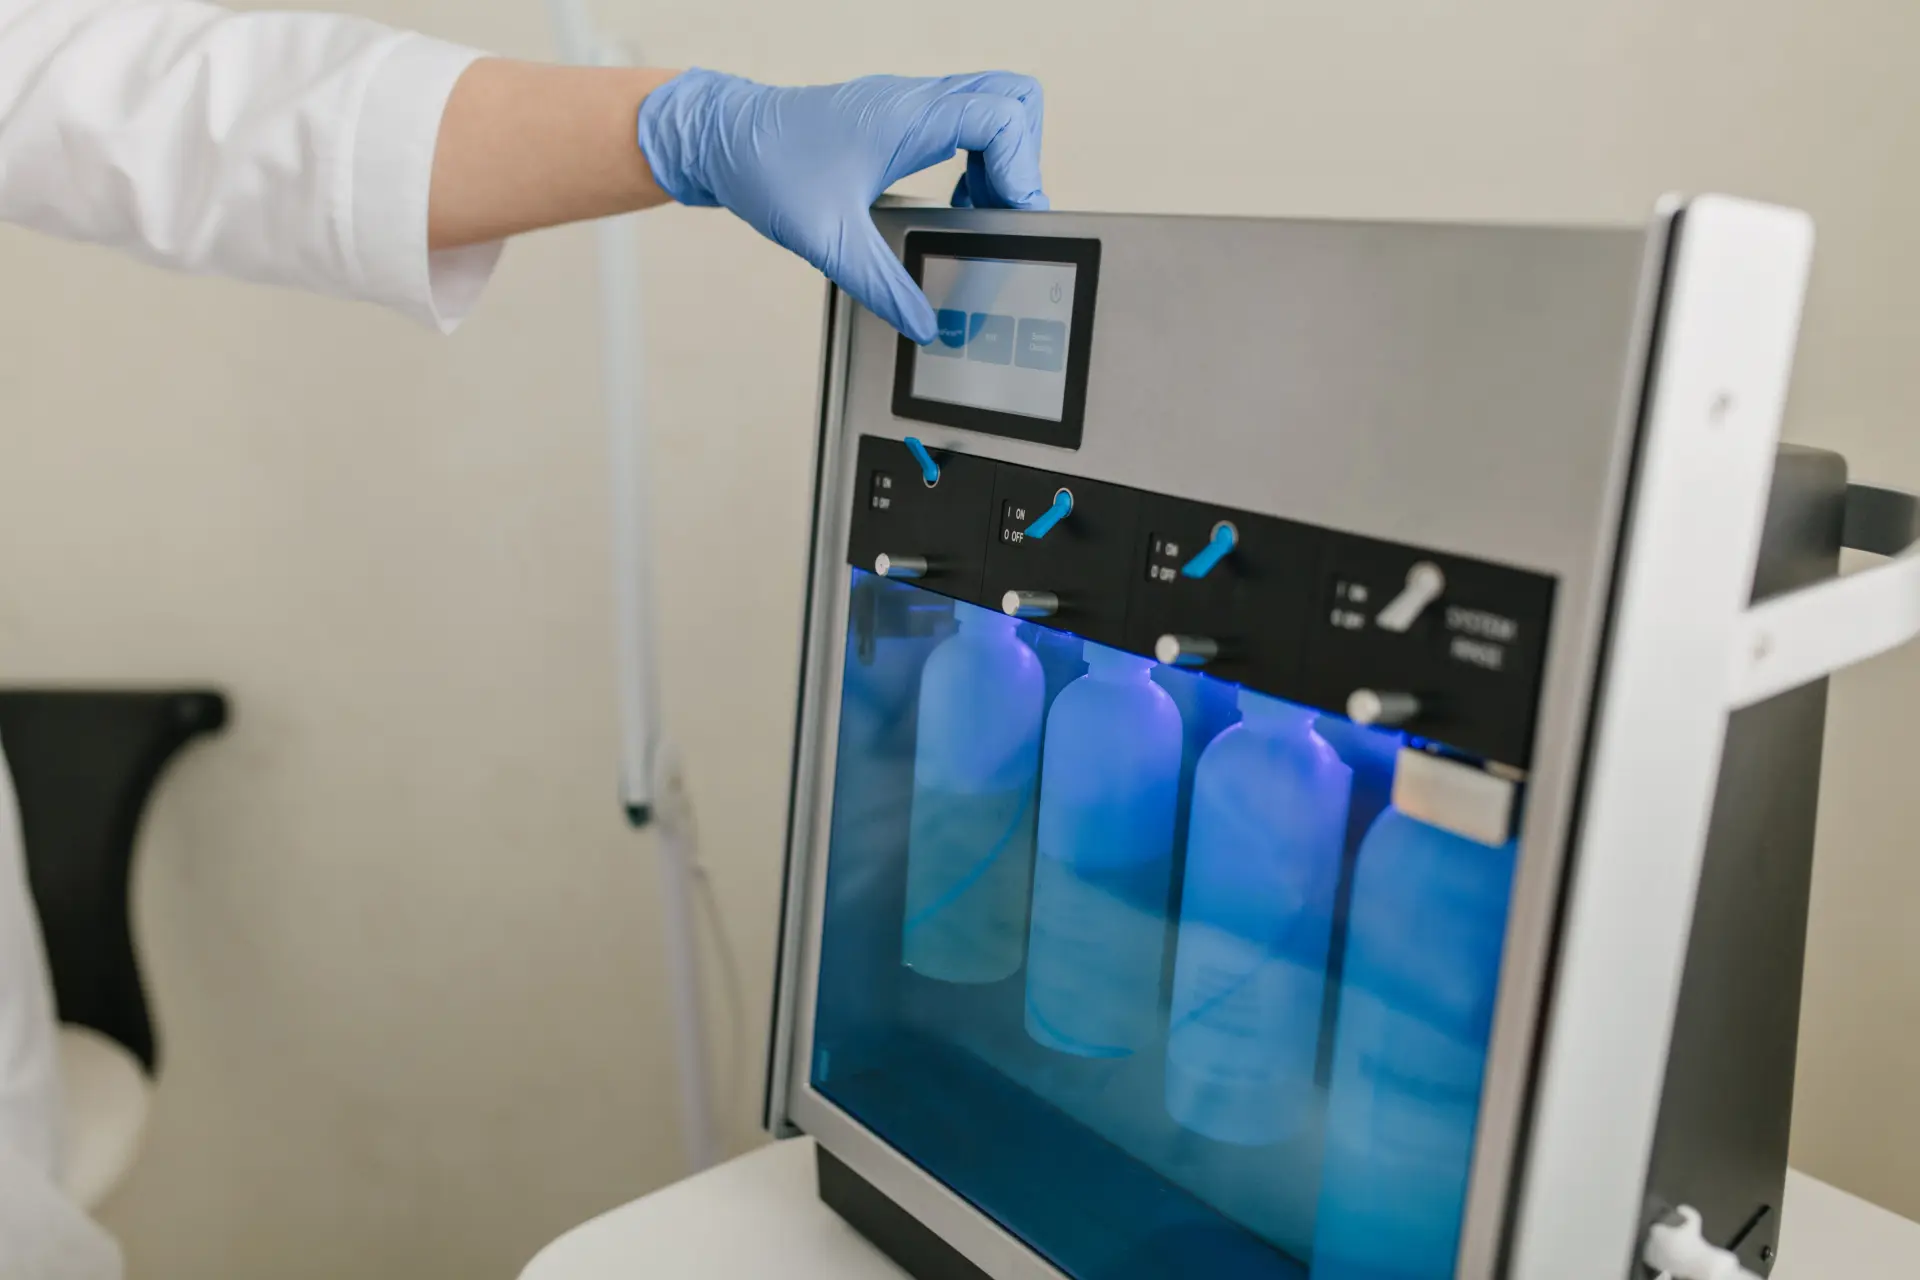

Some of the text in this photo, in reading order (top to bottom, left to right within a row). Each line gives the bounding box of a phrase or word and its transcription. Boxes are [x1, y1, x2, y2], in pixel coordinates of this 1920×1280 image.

[879, 497, 890, 508] OFF
[1016, 508, 1025, 520] ON
[1012, 531, 1024, 543] OFF
[1165, 543, 1178, 556] ON
[1160, 567, 1176, 582] OFF
